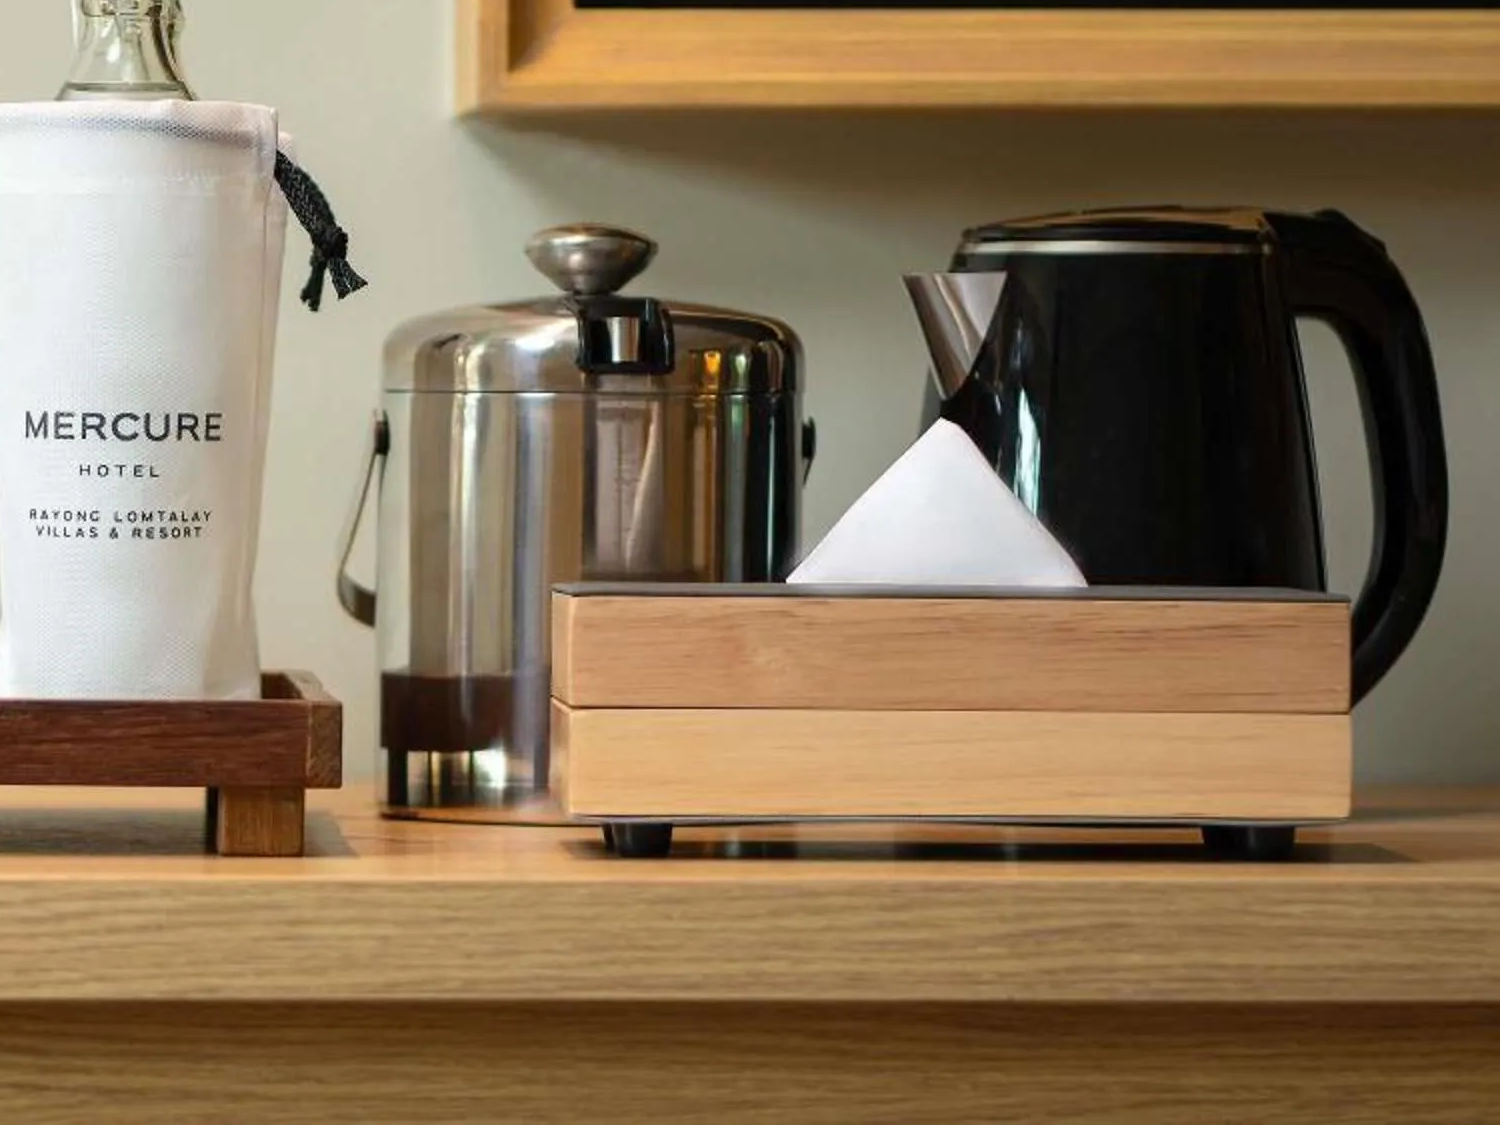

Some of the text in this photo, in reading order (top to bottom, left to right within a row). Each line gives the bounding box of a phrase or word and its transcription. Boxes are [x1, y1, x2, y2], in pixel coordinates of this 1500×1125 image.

[24, 410, 223, 442] MERCURE
[79, 464, 160, 478] HOTEL
[29, 509, 212, 524] RAYONG LOMTALAY
[36, 526, 203, 540] VILLAS & RESORT
